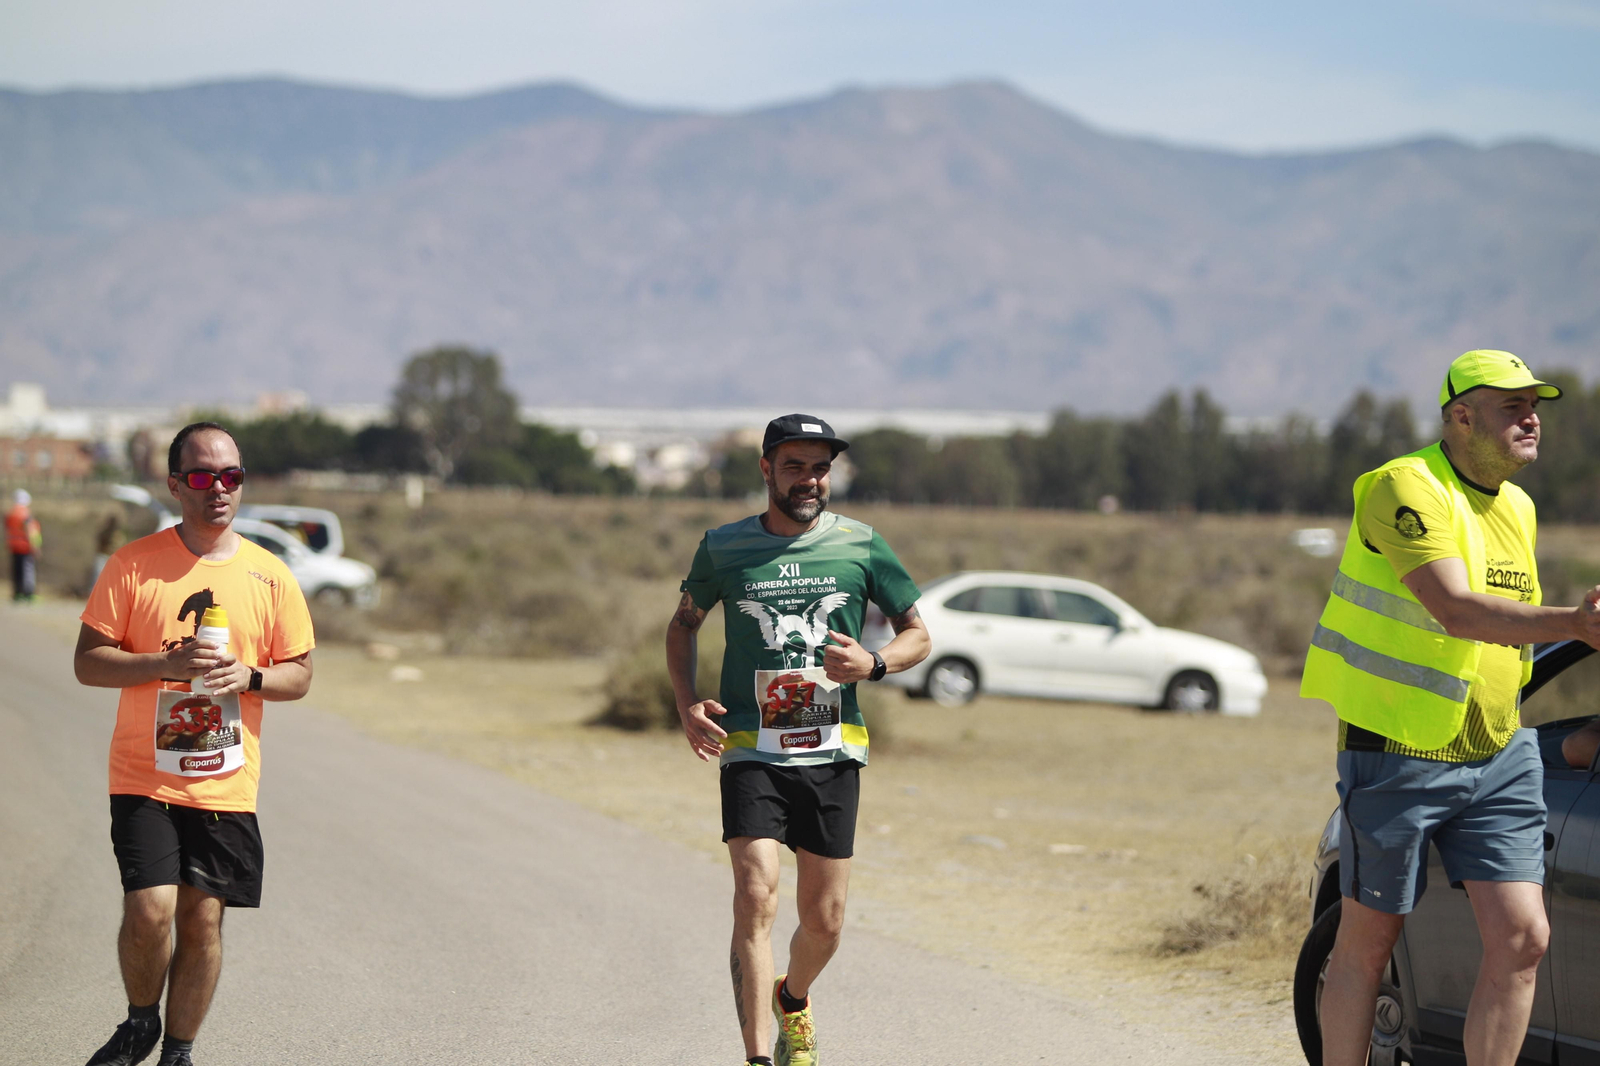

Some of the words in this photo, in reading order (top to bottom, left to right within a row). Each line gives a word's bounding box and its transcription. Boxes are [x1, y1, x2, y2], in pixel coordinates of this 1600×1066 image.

[778, 563, 800, 578] XII
[745, 580, 790, 591] CARRERA
[792, 577, 836, 586] POPULAR
[758, 588, 797, 598] ESPARTANOS
[766, 682, 816, 710] 577
[802, 704, 832, 714] XIII
[169, 705, 222, 732] 538
[208, 726, 234, 737] XIII
[783, 733, 818, 745] Caparrós
[184, 756, 222, 768] Caparrós
